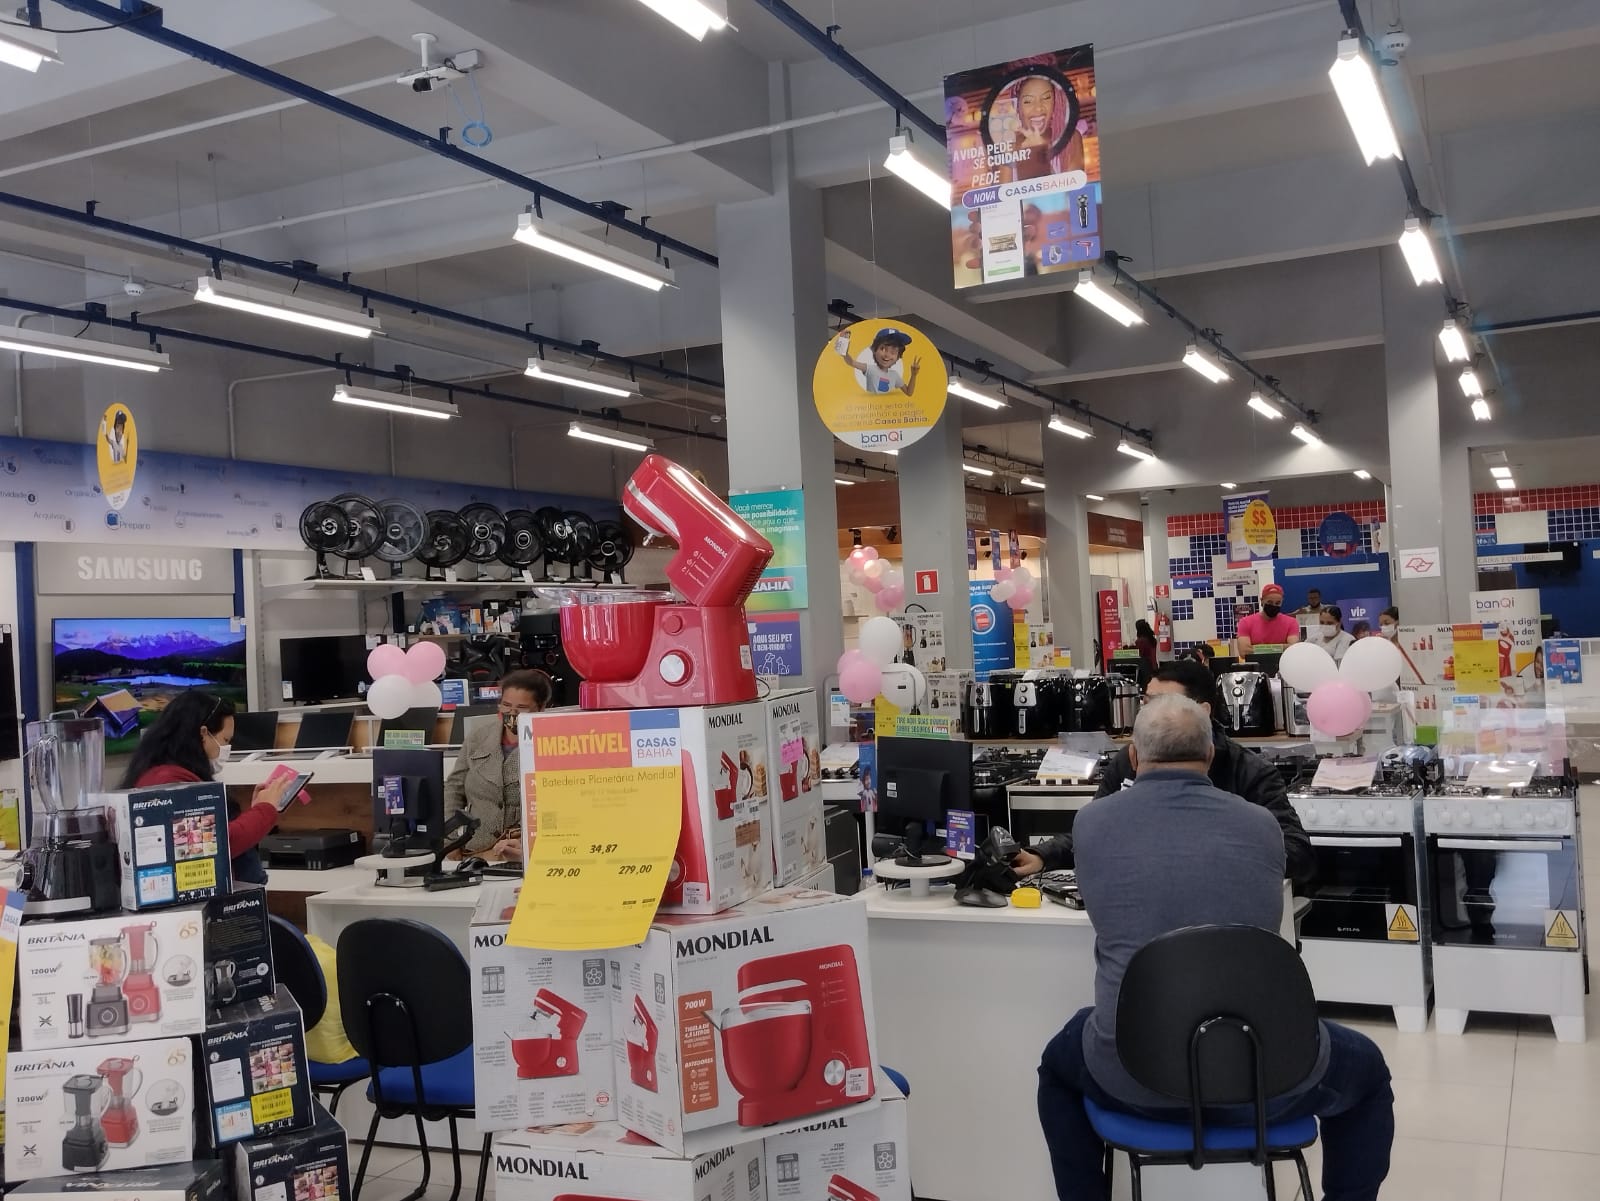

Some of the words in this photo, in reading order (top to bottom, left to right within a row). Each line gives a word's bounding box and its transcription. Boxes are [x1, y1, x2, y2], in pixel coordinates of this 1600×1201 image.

[960, 146, 985, 161] VIDA
[986, 140, 1014, 156] PEDE
[972, 157, 986, 170] SE
[987, 148, 1032, 167] CUIDAR?
[971, 170, 1001, 188] PEDE
[973, 190, 996, 204] NOVA
[874, 417, 901, 425] Casas
[861, 430, 903, 444] banQi
[751, 502, 774, 511] merece
[704, 535, 728, 559] MONDIAL
[77, 555, 203, 582] SAMSUNG
[752, 580, 791, 592] BAHIA
[1476, 597, 1515, 609] banQi
[753, 634, 768, 644] AQUI
[768, 633, 780, 643] SEU
[781, 633, 793, 643] PET
[772, 702, 801, 720] MONDIAL
[708, 712, 744, 729] MONDIAL
[536, 728, 629, 757] IMBATÍVEL
[636, 736, 677, 748] CASAS
[636, 748, 674, 760] BAHIA
[541, 775, 586, 788] Batedeira
[588, 773, 634, 785] Planetária
[636, 767, 677, 781] Mondial
[589, 843, 618, 855] 34,87
[546, 867, 582, 878] 279,00
[618, 864, 653, 876] 279,00
[179, 921, 199, 939] 65
[676, 925, 774, 959] MONDIAL
[31, 967, 58, 975] 1200W
[818, 960, 845, 970] MONDIAL
[684, 998, 707, 1010] 700W
[167, 1048, 187, 1067] 65
[17, 1094, 45, 1103] 1200W
[496, 1155, 589, 1181] MONDIAL
[694, 1144, 736, 1184] MONDIAL
